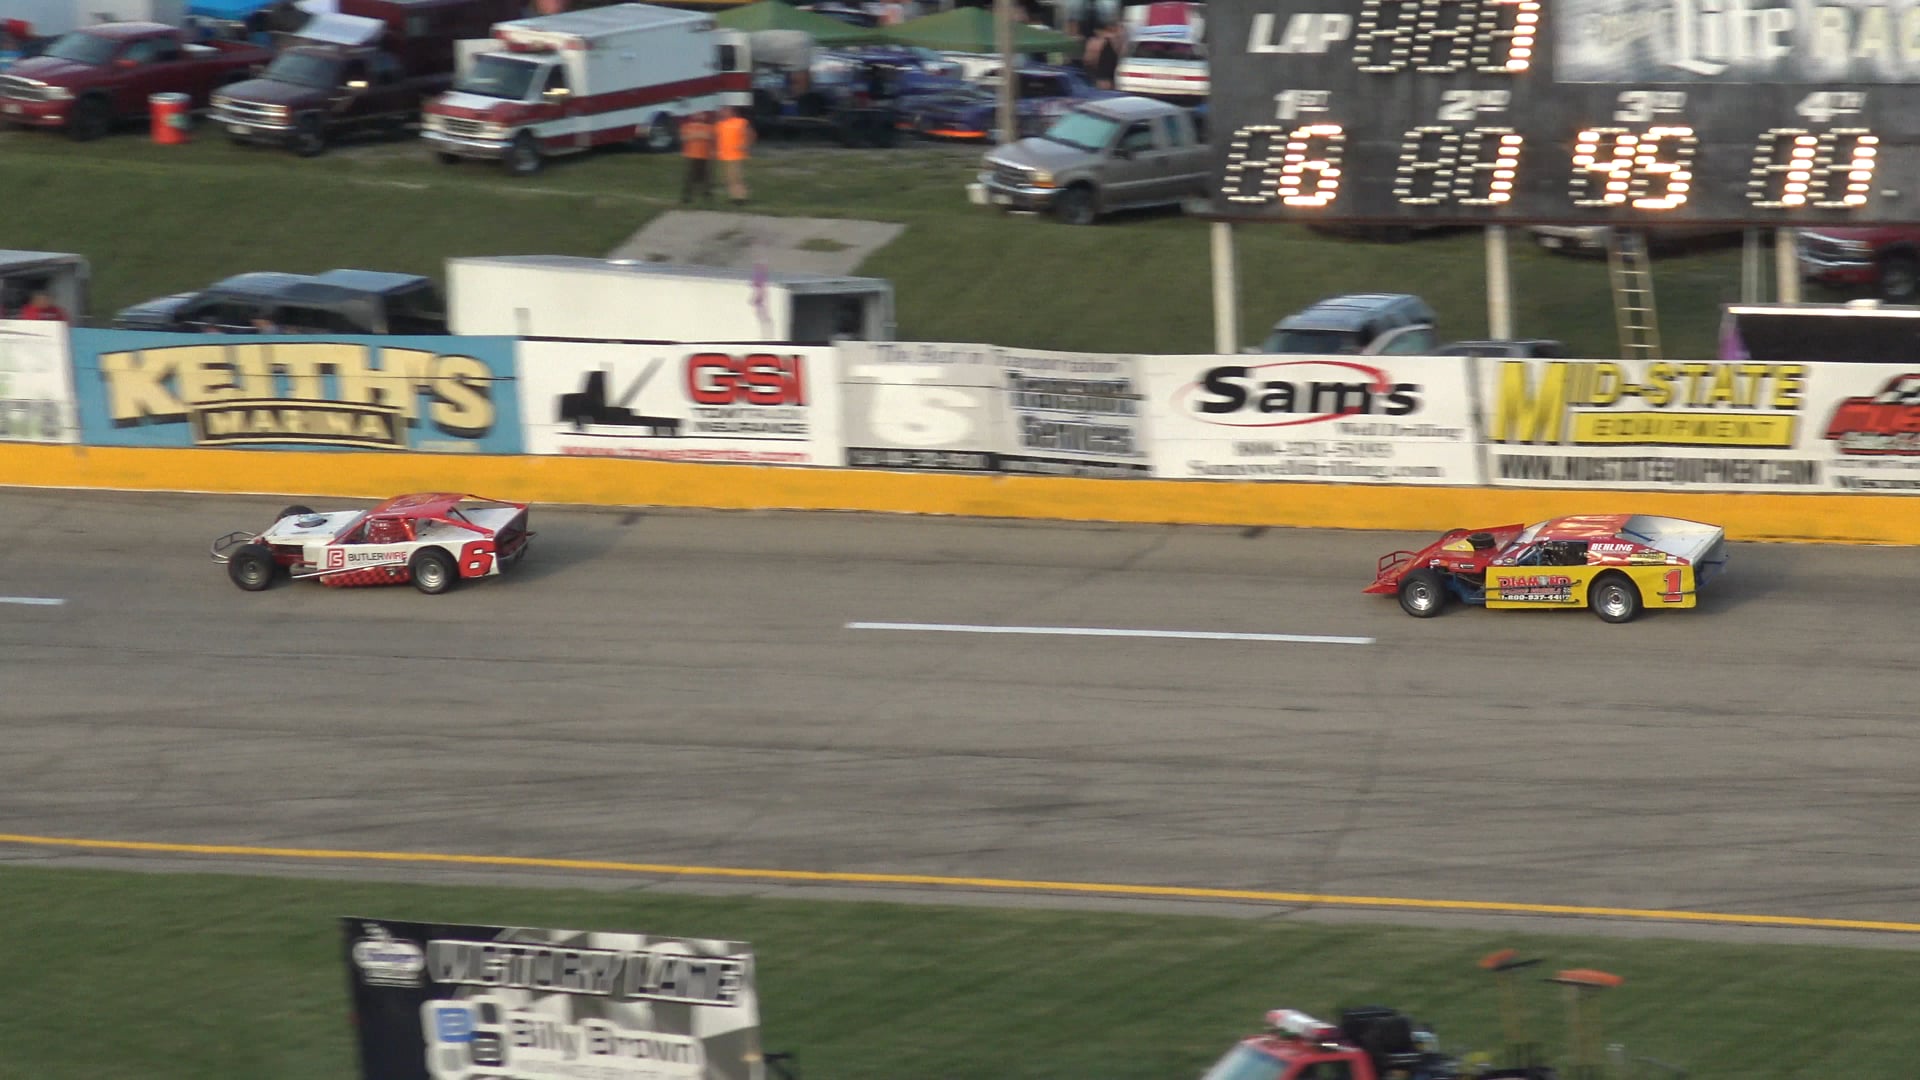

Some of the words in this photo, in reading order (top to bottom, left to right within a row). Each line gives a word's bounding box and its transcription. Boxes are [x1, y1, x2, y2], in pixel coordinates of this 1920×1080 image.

[1247, 13, 1352, 53] LAP
[1571, 126, 1692, 209] 45
[100, 342, 496, 437] KEITH'S
[684, 352, 808, 406] GSI
[1489, 361, 1806, 444] MID-STATE
[1591, 418, 1779, 438] EQUIPMENT
[459, 540, 497, 579] 6
[1663, 569, 1683, 602] 1
[510, 1018, 580, 1061] Billy
[589, 1026, 705, 1064] Brown
